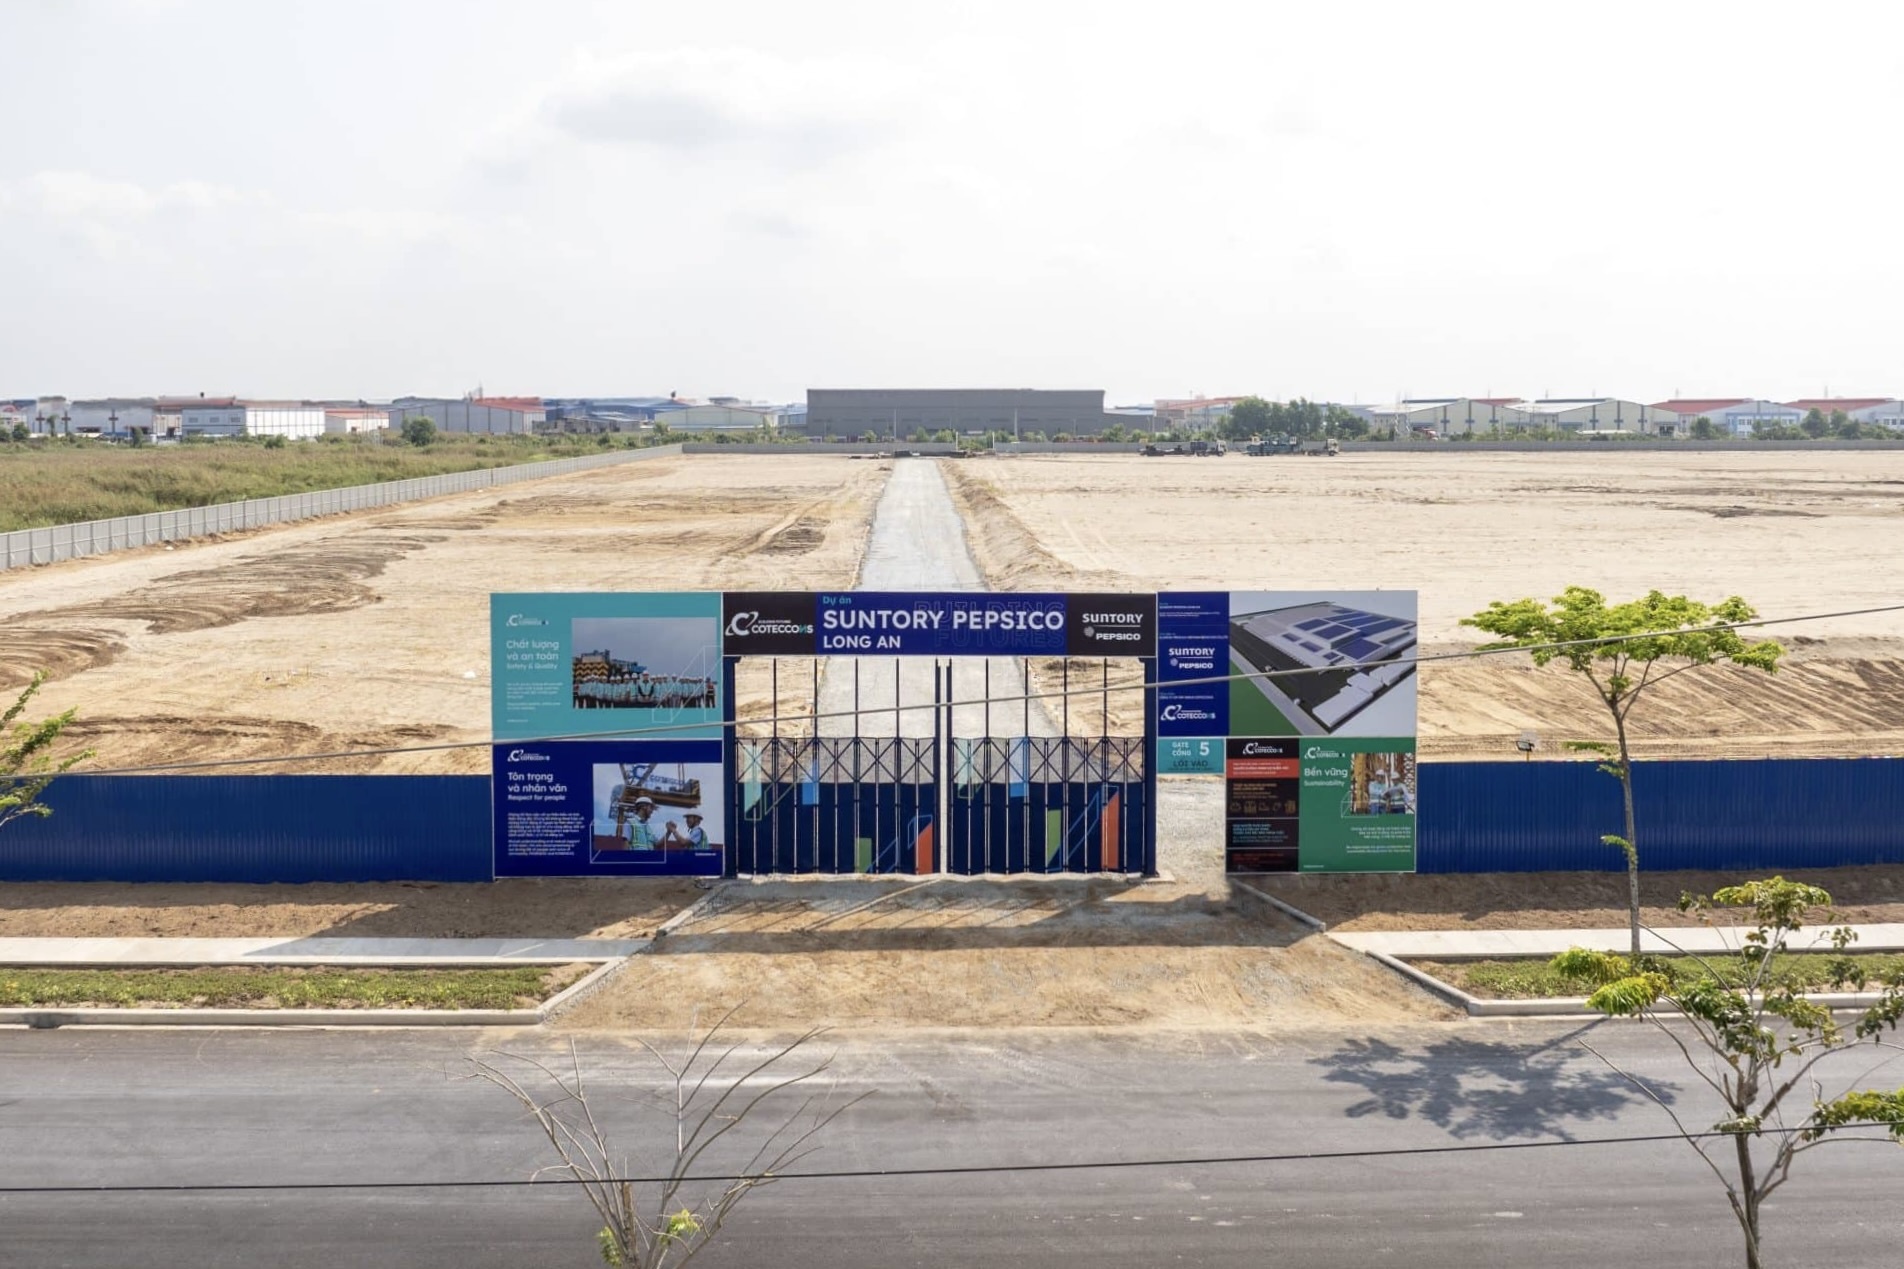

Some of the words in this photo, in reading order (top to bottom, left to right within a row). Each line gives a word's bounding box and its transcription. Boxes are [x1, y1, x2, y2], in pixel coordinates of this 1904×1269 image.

[823, 609, 944, 629] SUNTORY
[952, 610, 1065, 630] PEPSICO
[1082, 613, 1143, 624] SUNTORY
[823, 635, 872, 649] LONG
[876, 635, 901, 649] AN
[1096, 632, 1141, 641] PEPSICO
[1168, 648, 1215, 656] SUNTORY
[1199, 741, 1210, 756] 5
[507, 772, 525, 781] Tôn
